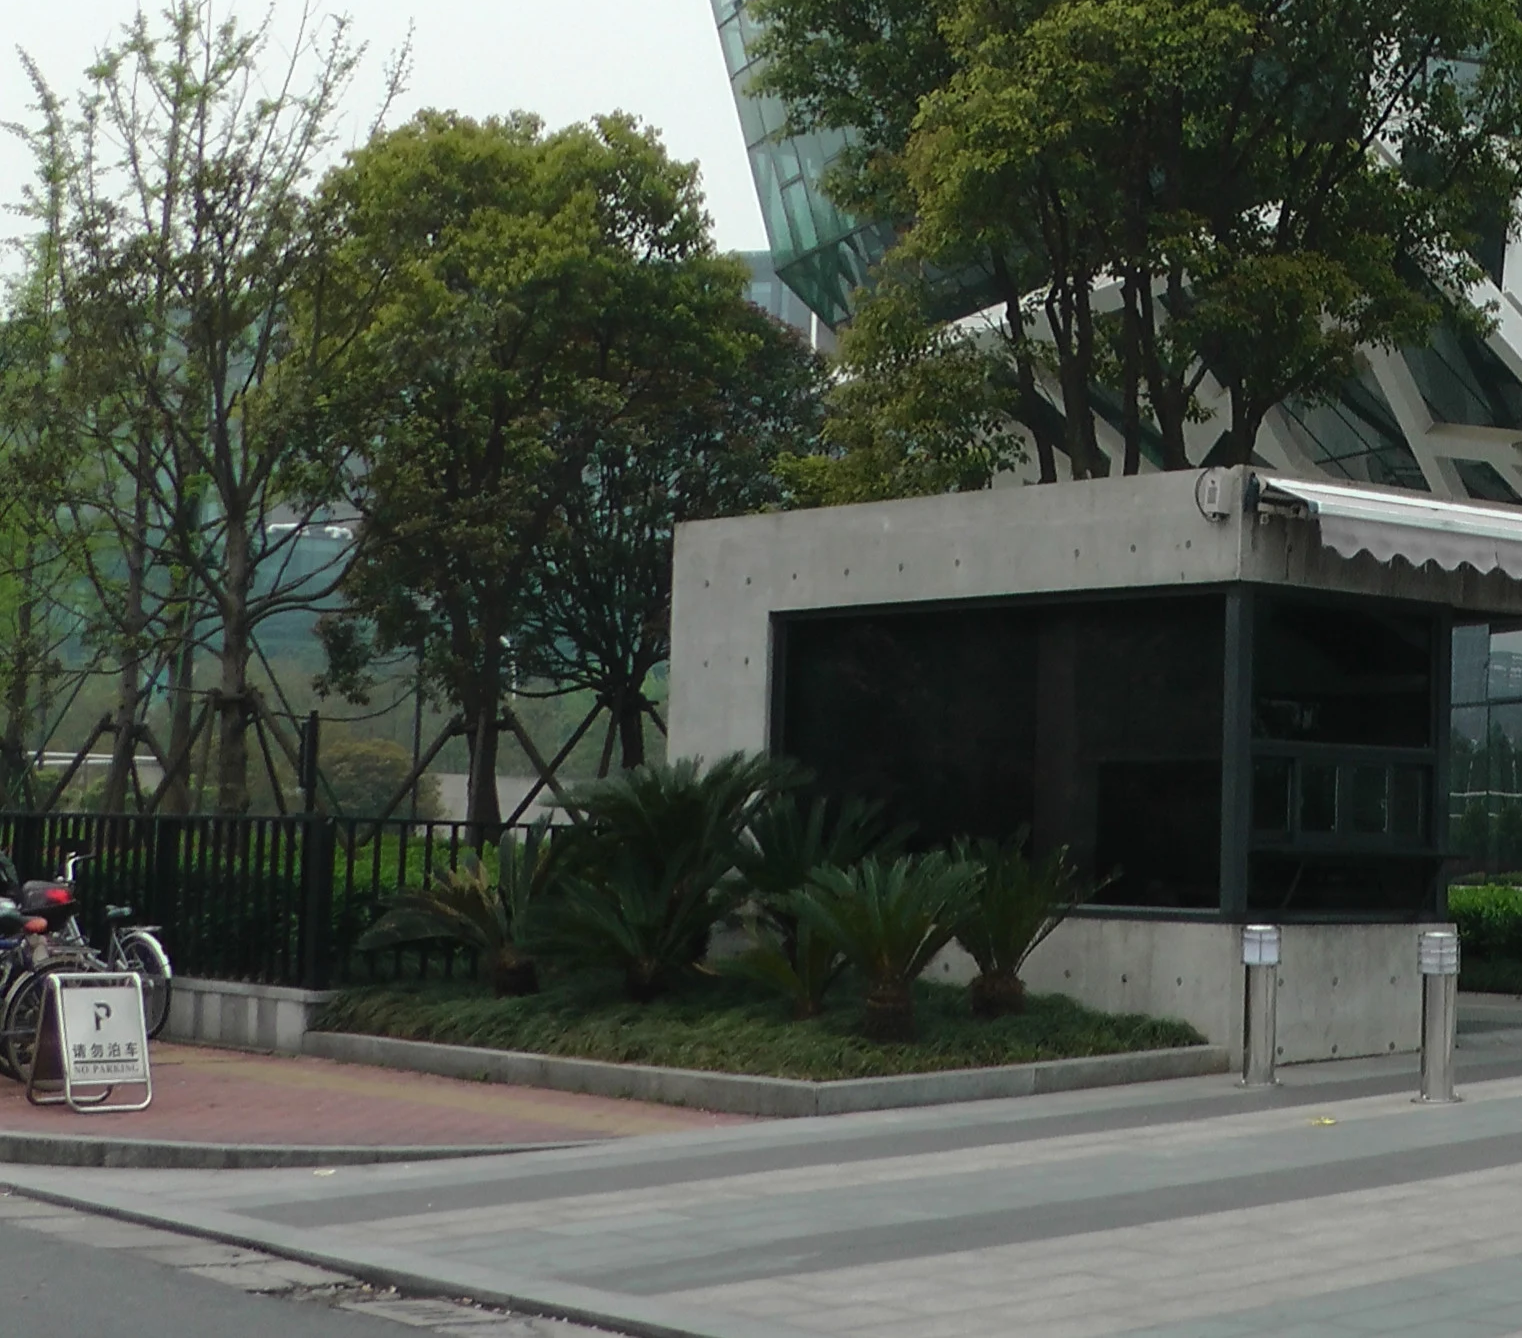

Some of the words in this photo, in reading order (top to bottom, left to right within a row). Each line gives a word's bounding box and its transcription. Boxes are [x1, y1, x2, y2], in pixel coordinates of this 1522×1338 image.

[94, 1002, 112, 1031] P
[72, 1042, 138, 1059] 请勿泊车
[75, 1065, 90, 1074] NO
[93, 1064, 139, 1074] PARKING
